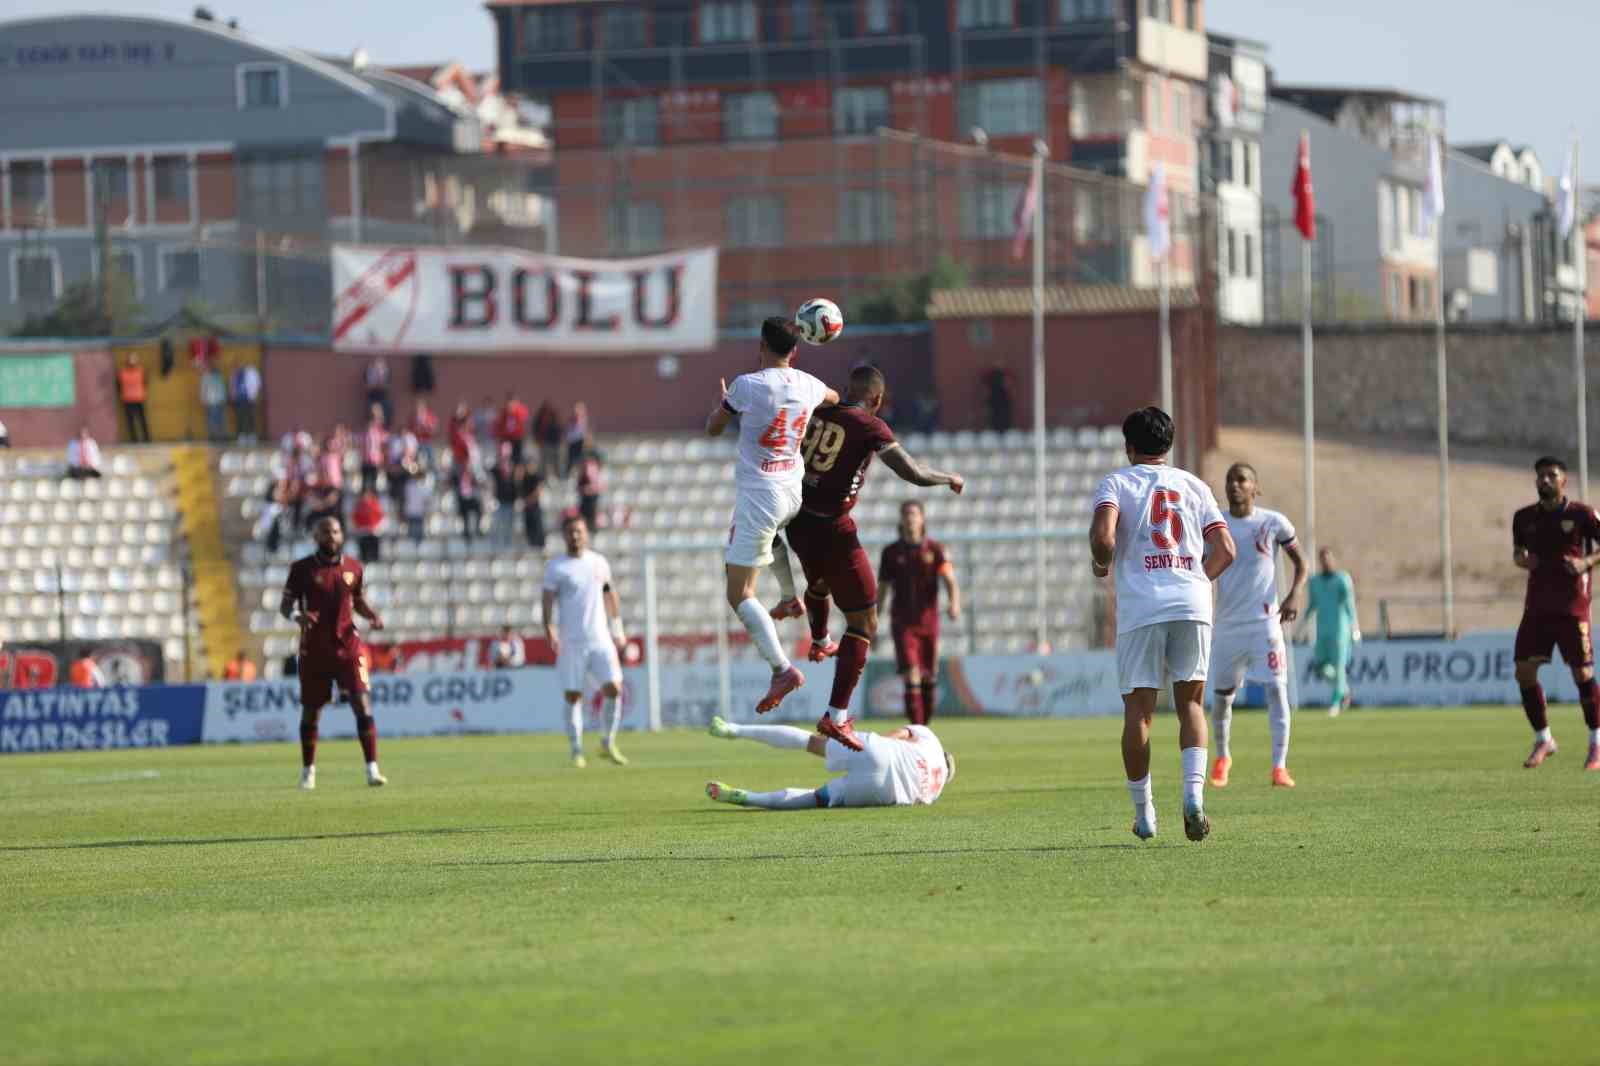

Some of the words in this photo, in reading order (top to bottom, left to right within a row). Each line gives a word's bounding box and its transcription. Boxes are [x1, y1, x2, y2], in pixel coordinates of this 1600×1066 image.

[447, 260, 686, 332] BOLU
[803, 417, 846, 471] 99
[1151, 490, 1184, 550] 5
[423, 673, 514, 705] GRUP
